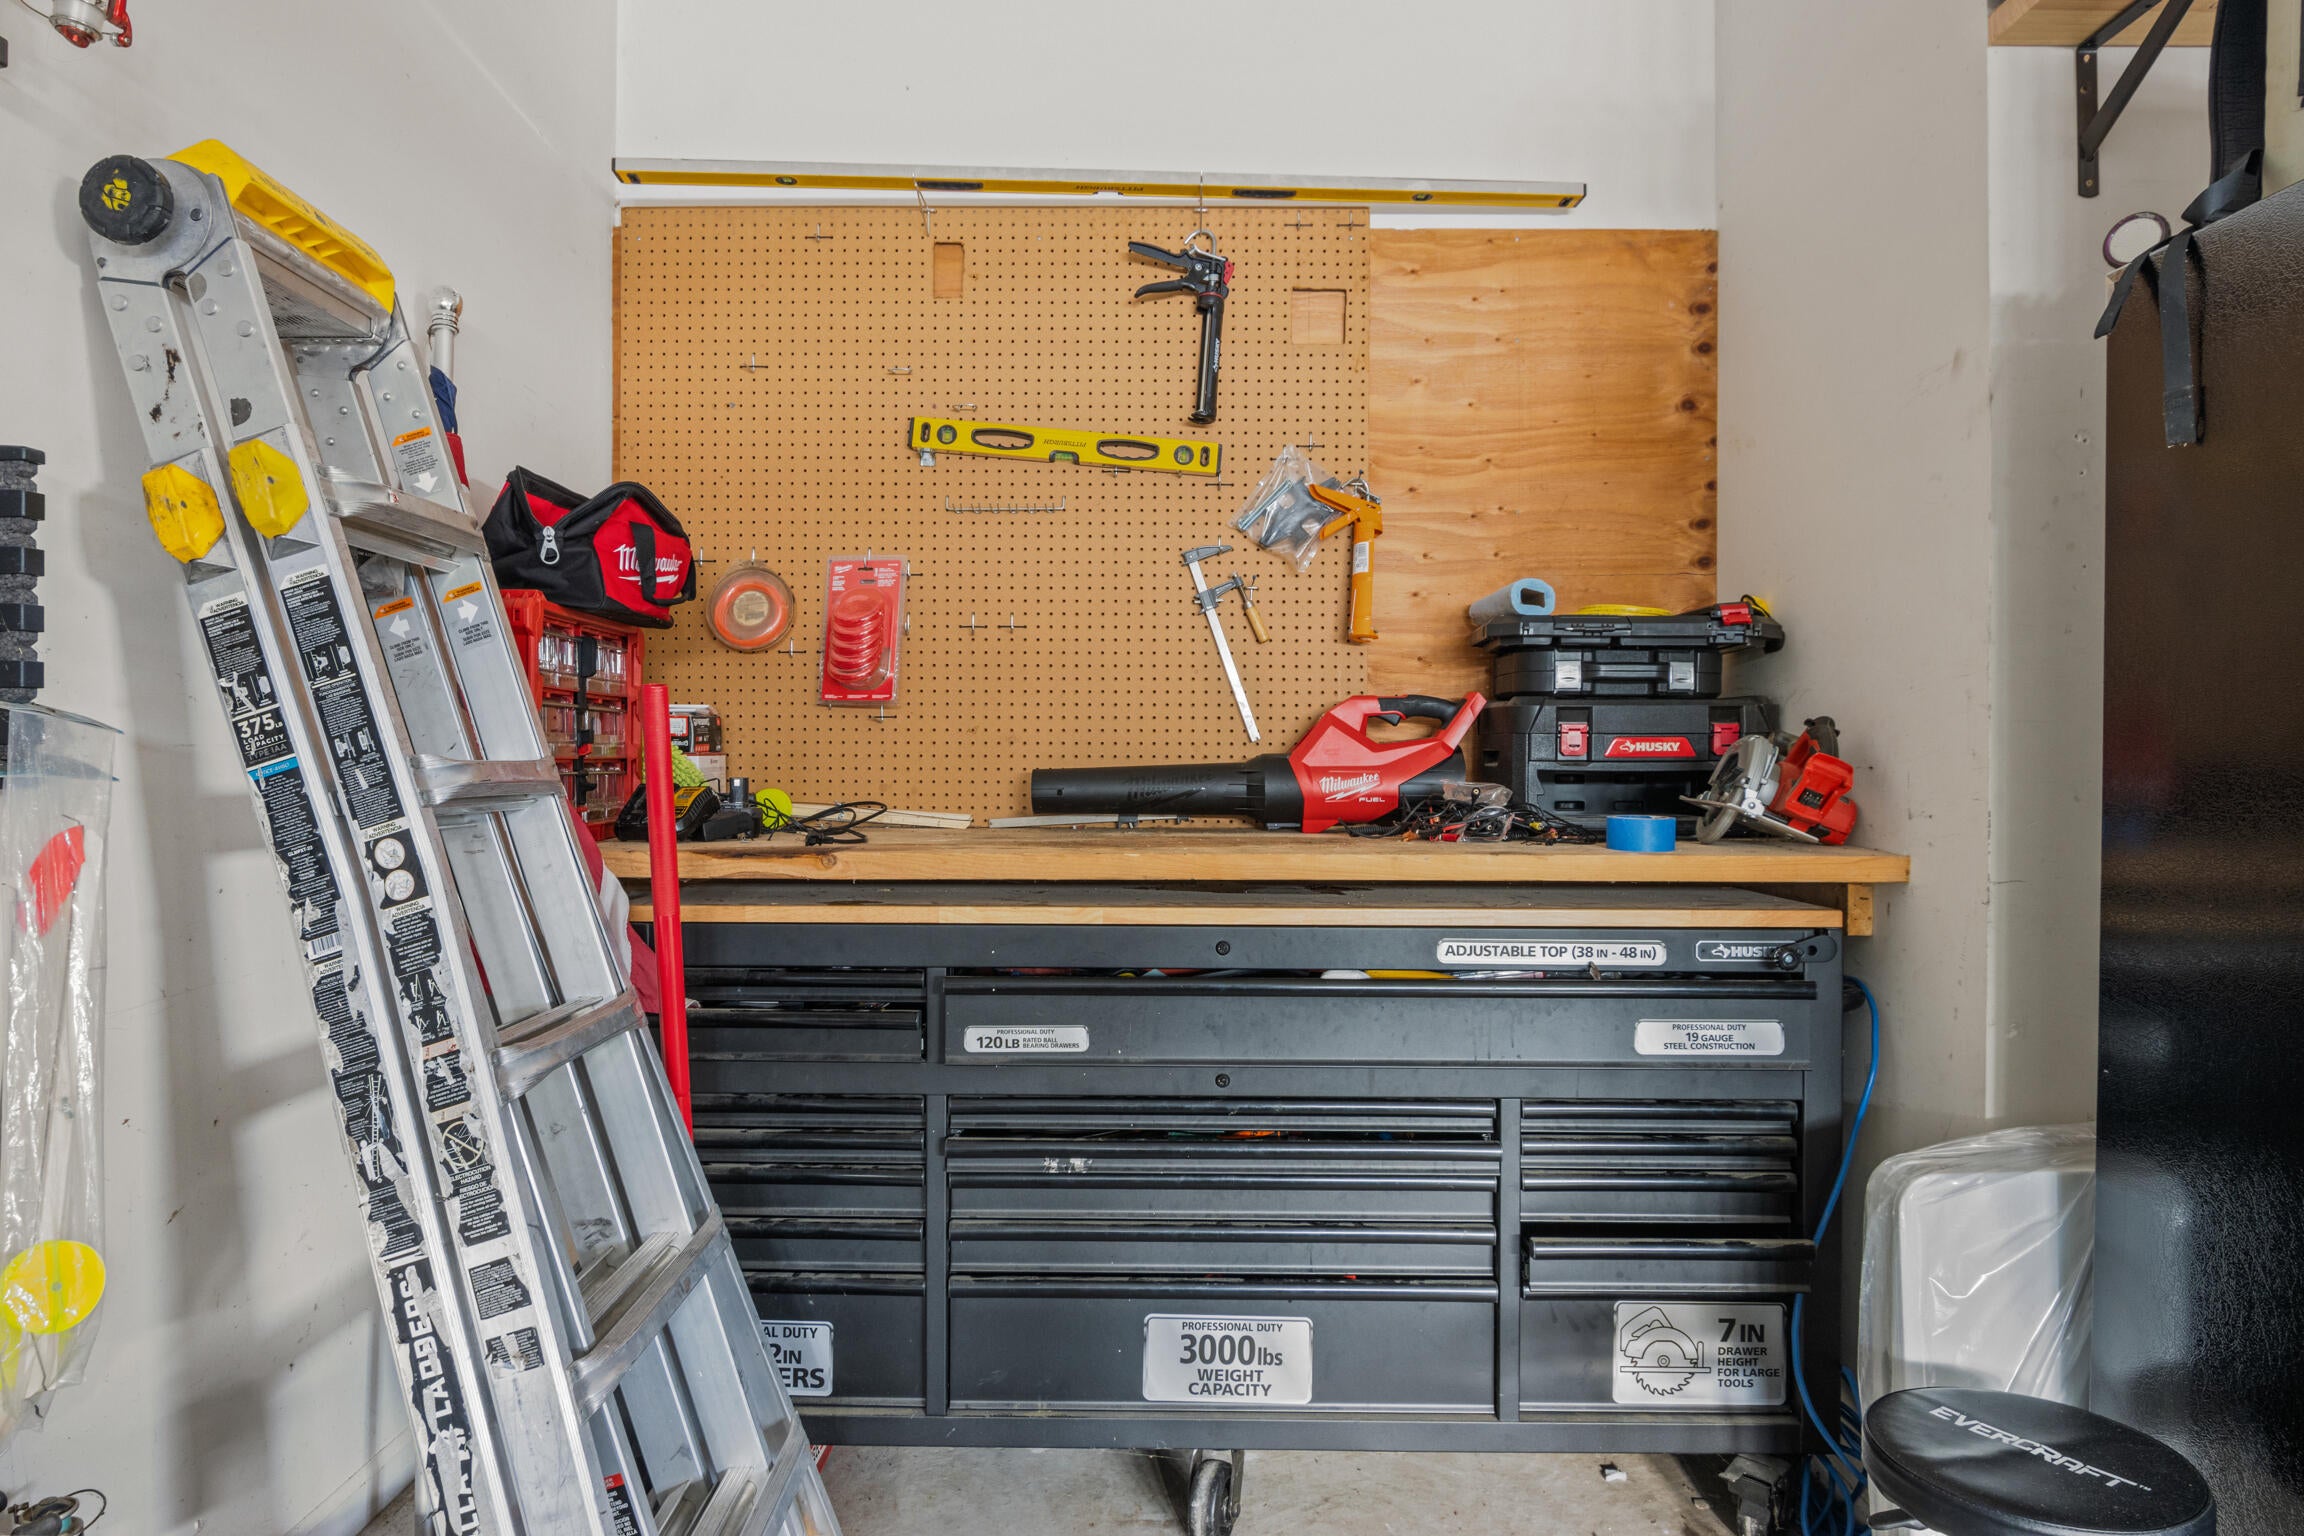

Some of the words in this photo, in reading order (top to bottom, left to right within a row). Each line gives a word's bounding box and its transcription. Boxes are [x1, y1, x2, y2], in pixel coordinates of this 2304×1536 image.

[242, 733, 265, 745] LOAD
[244, 733, 284, 750] CPACITY
[1635, 741, 1680, 752] HUSKY
[1319, 773, 1379, 793] Milwaukee
[1445, 945, 1536, 958] ADJUSTABLE
[1540, 945, 1567, 958] TOP
[1571, 946, 1593, 959] (38
[1596, 949, 1608, 958] IN
[1619, 946, 1637, 959] 48
[1640, 946, 1657, 960] IN)
[976, 1036, 1003, 1049] 120
[1005, 1038, 1020, 1049] LB
[1685, 1032, 1699, 1042] 19
[1701, 1034, 1734, 1042] GAUGE
[1663, 1042, 1688, 1050] STEEL
[1690, 1042, 1755, 1050] CONSTRUCTION
[1182, 1321, 1253, 1332] PROFESSIONAL
[1257, 1323, 1283, 1332] DUTY
[1718, 1318, 1736, 1342] 7
[1740, 1324, 1765, 1343] IN
[783, 1327, 818, 1339] DUTY
[1718, 1347, 1768, 1356] DRAWER
[1717, 1357, 1758, 1366] HEIGHT
[1197, 1368, 1264, 1382] WEIGHT
[1717, 1368, 1740, 1377] FOR
[1743, 1368, 1781, 1377] LARGE
[1717, 1378, 1754, 1388] TOOLS
[1188, 1382, 1272, 1397] CAPACITY
